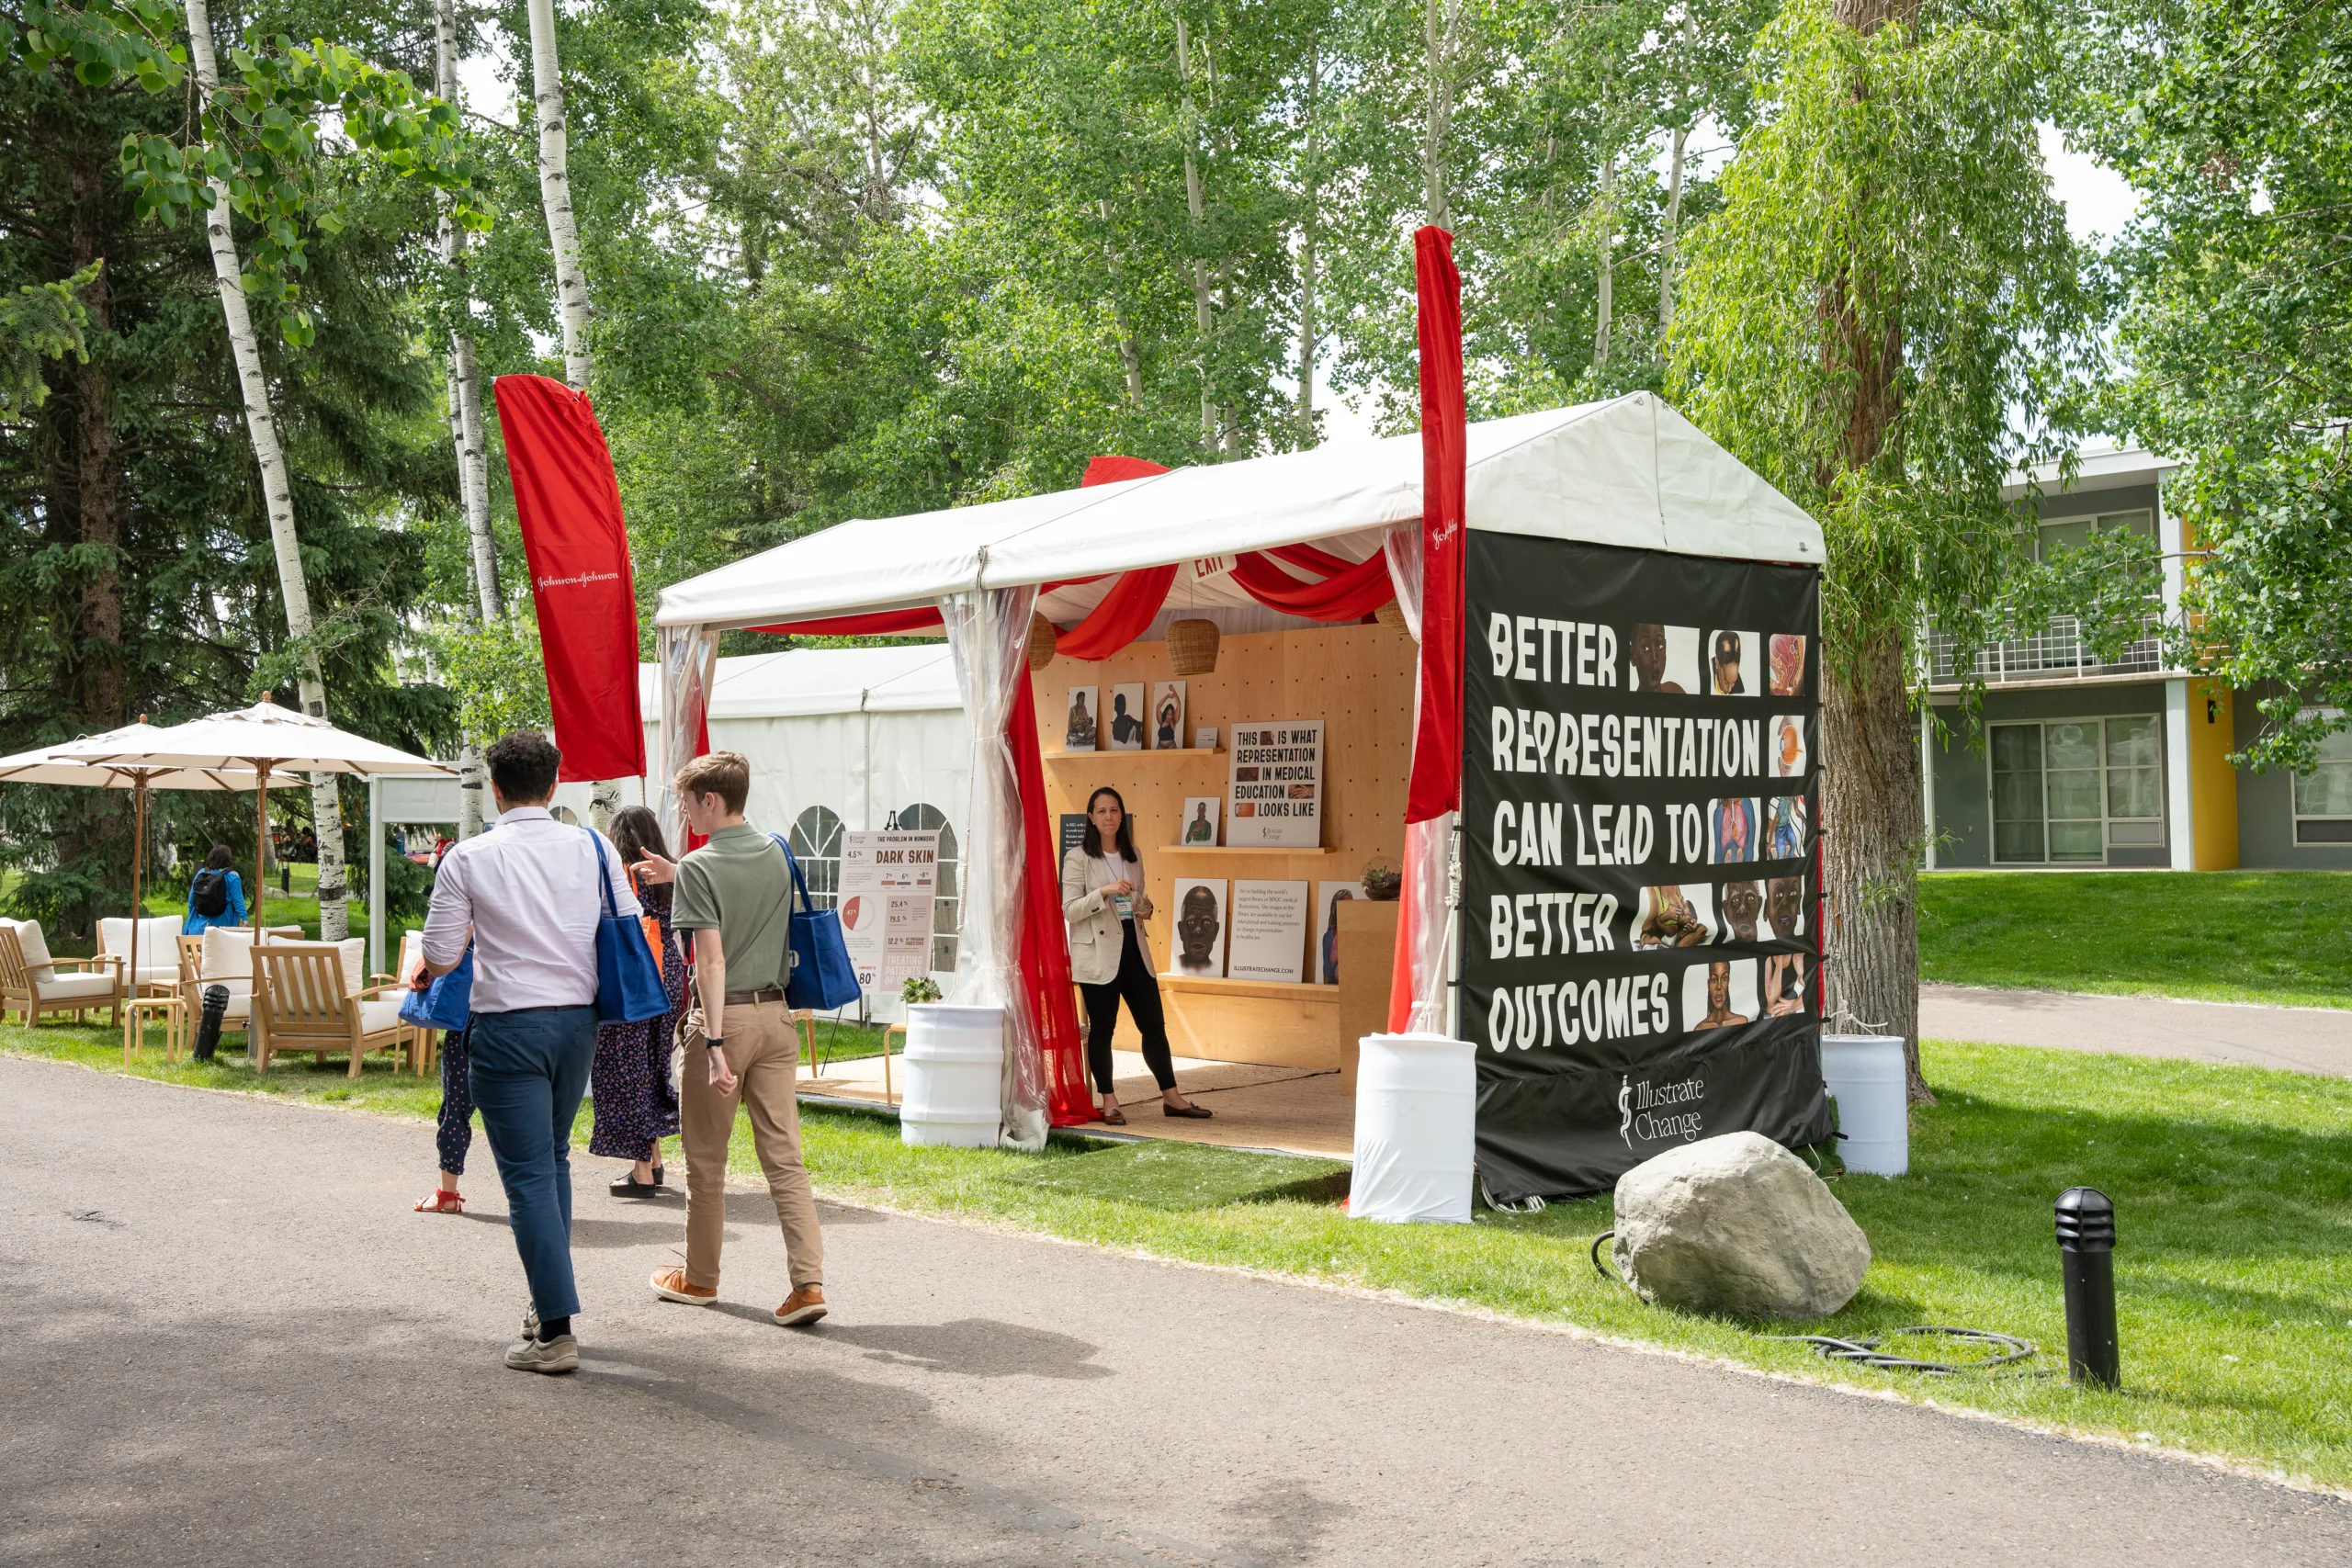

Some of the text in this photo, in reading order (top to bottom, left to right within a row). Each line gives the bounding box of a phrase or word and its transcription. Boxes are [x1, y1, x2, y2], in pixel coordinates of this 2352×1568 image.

[1488, 613, 1618, 687] BETTER
[1238, 729, 1317, 746] THIS IS WHAT
[1492, 706, 1760, 778] REPRESENTATION
[1237, 748, 1316, 763] REPRESENTATION
[1262, 766, 1315, 781] IN MEDICAL
[1235, 785, 1285, 799] EDUCATION
[1258, 803, 1314, 817] LOOKS LIKE
[1493, 801, 1702, 865] CAN LEAD TO
[876, 850, 904, 863] DARK
[909, 850, 933, 863] SKIN
[1490, 893, 1619, 959] BETTER
[887, 955, 922, 964] TREATING
[885, 965, 922, 976] PATIENTS
[1234, 965, 1294, 974] ILLUSTRATECHANGE.COM
[885, 976, 895, 985] OF
[1488, 973, 1669, 1053] OUTCOMES
[1636, 1078, 1704, 1110] Illustrate
[1635, 1111, 1703, 1141] Change
